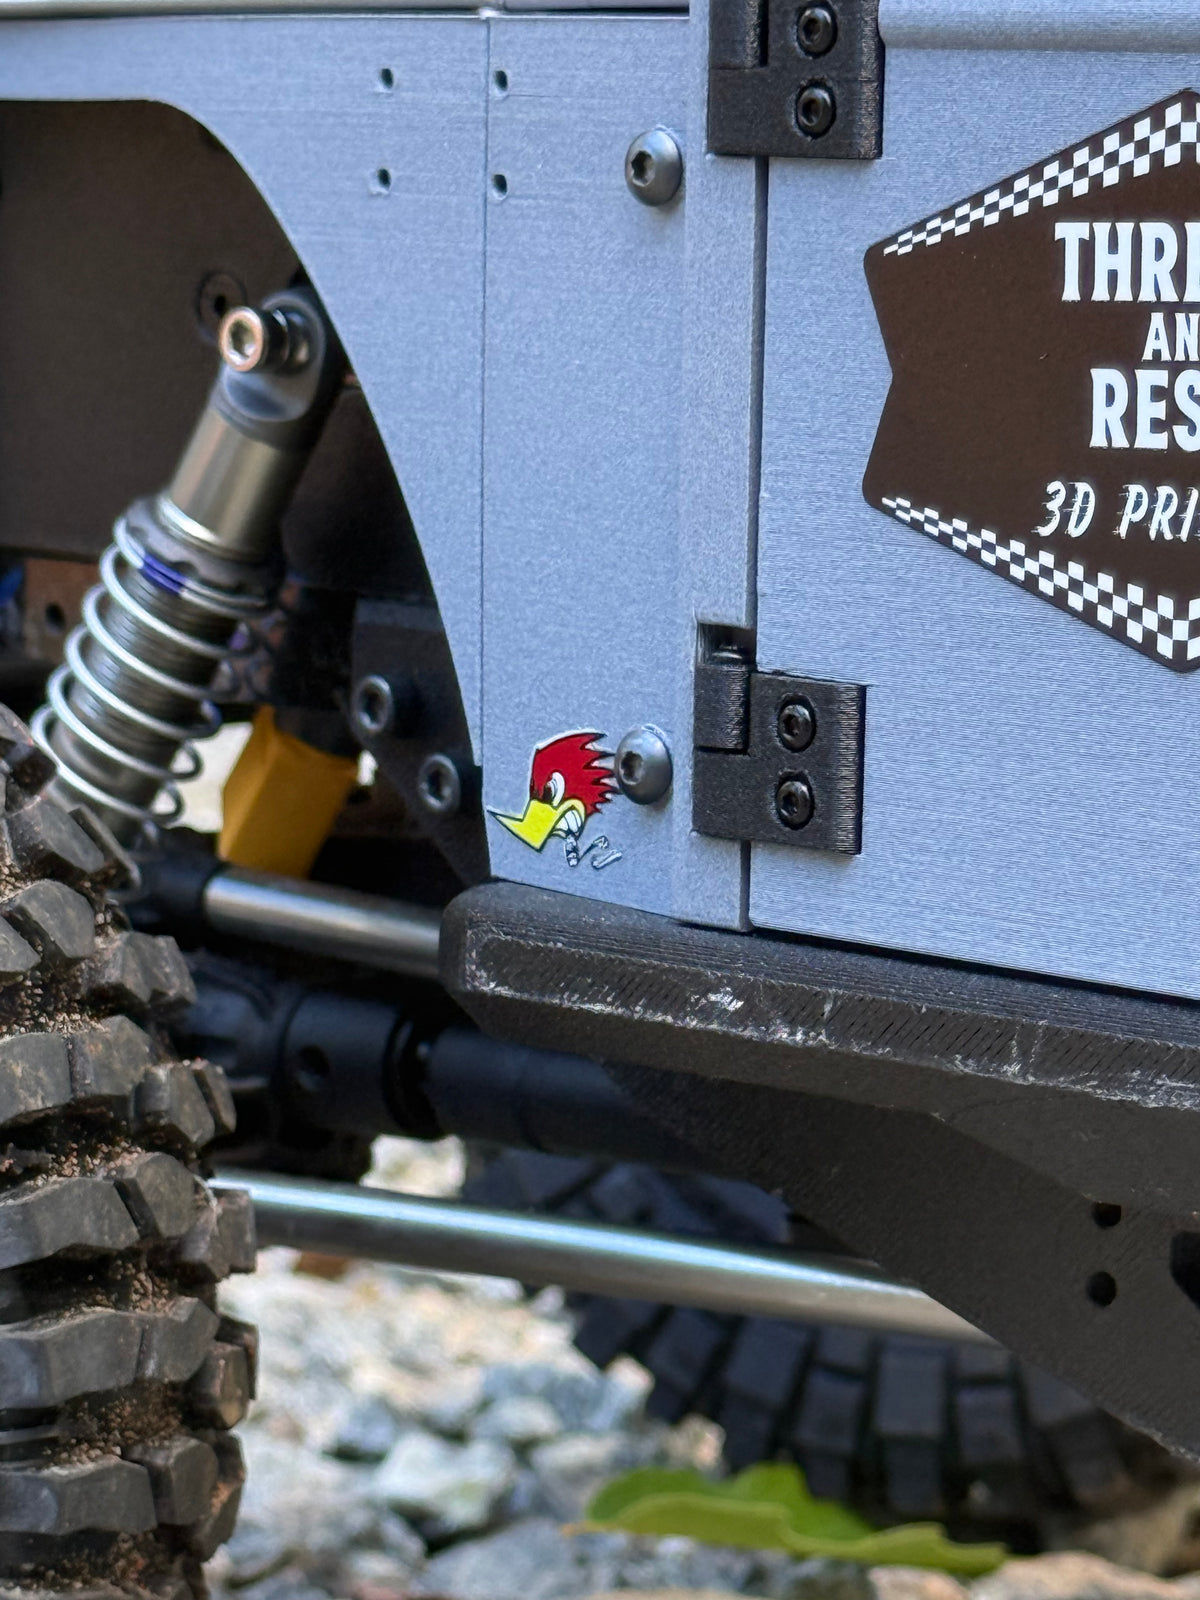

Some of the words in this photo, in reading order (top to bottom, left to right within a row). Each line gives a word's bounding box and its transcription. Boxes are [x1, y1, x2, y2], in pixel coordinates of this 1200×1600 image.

[1141, 311, 1200, 361] AN
[1089, 368, 1200, 452] RES
[1032, 480, 1096, 538] 3D
